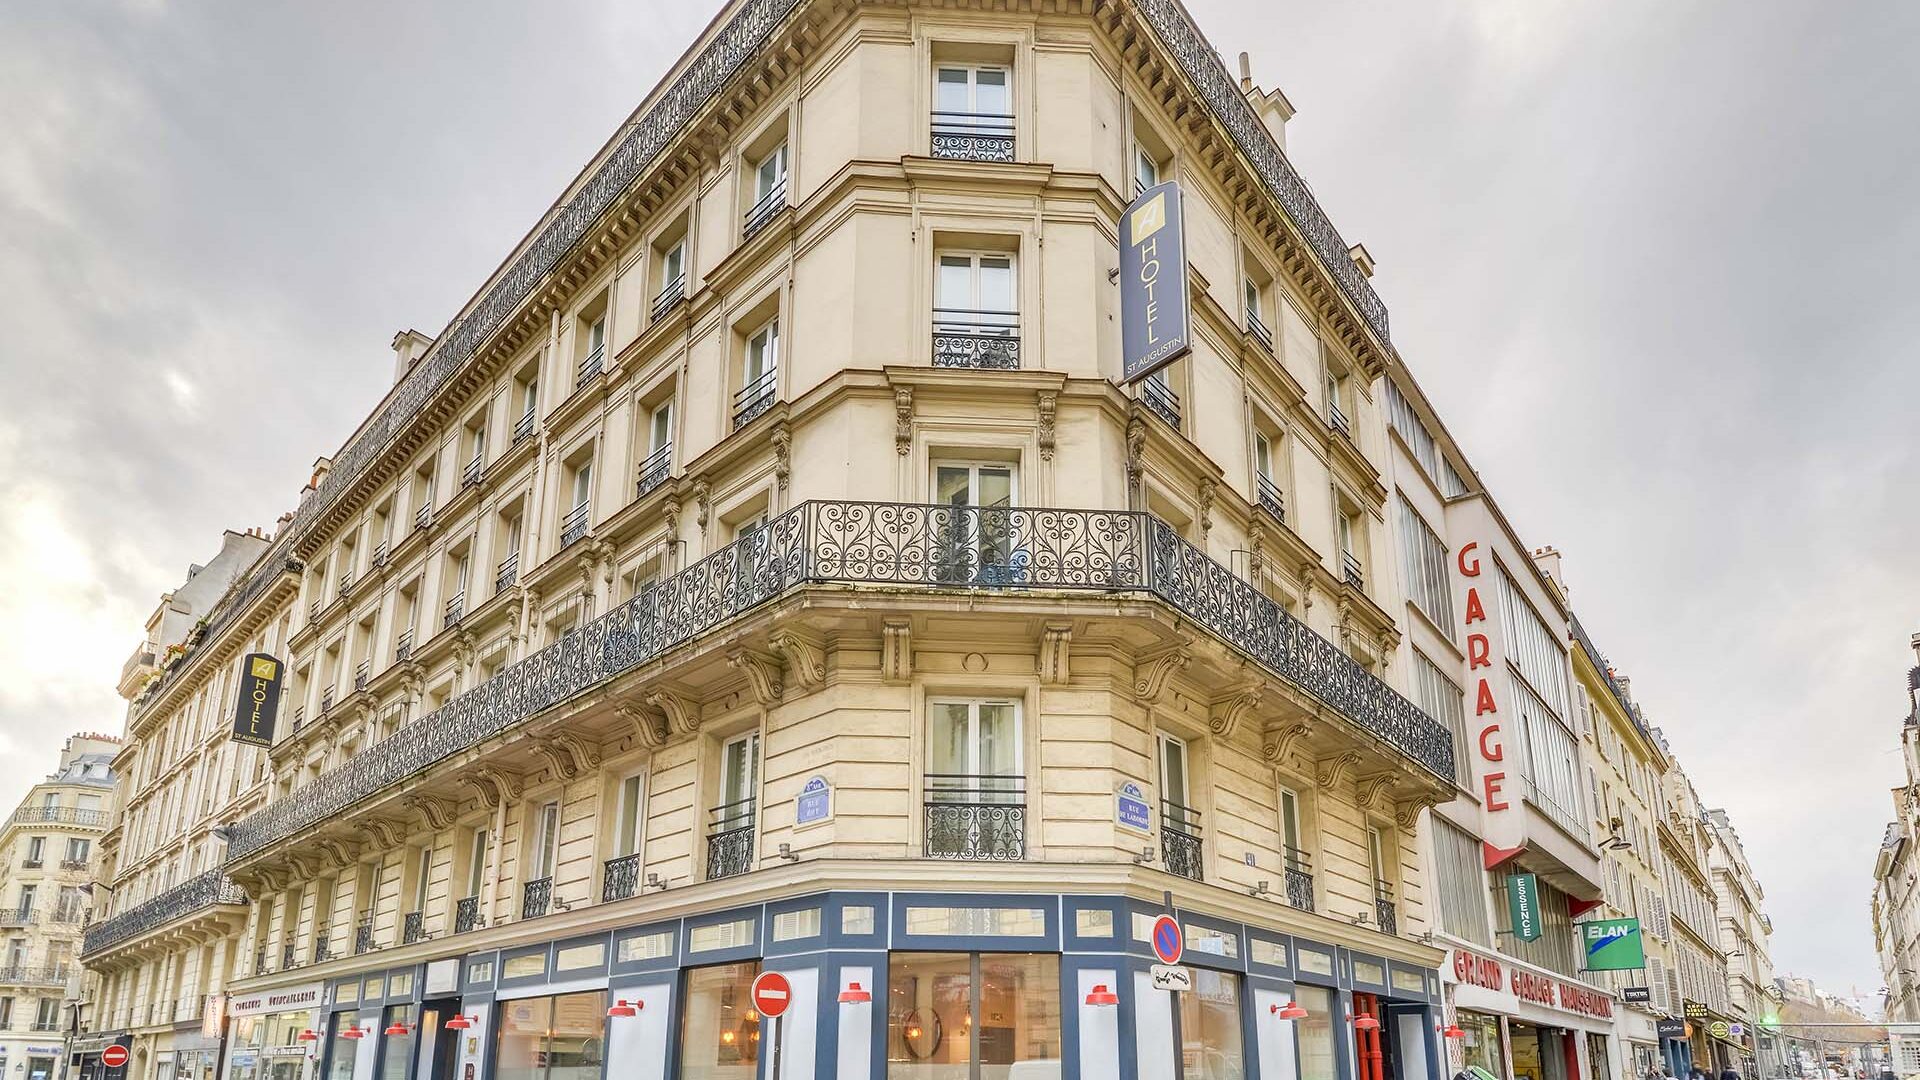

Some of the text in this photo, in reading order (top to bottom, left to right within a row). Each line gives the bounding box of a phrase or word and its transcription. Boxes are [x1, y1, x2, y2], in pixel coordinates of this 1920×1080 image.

[1141, 237, 1160, 345] HOTEL
[1127, 335, 1182, 375] ST AUGUSTIN
[1457, 541, 1509, 812] GARAGE
[250, 679, 267, 734] HOTEL
[242, 734, 271, 745] AUGUSTIN
[1516, 878, 1531, 937] ESSENCE
[1587, 925, 1628, 939] ELAN
[1453, 949, 1504, 992] GRAND
[1510, 968, 1557, 1007] GARAGE
